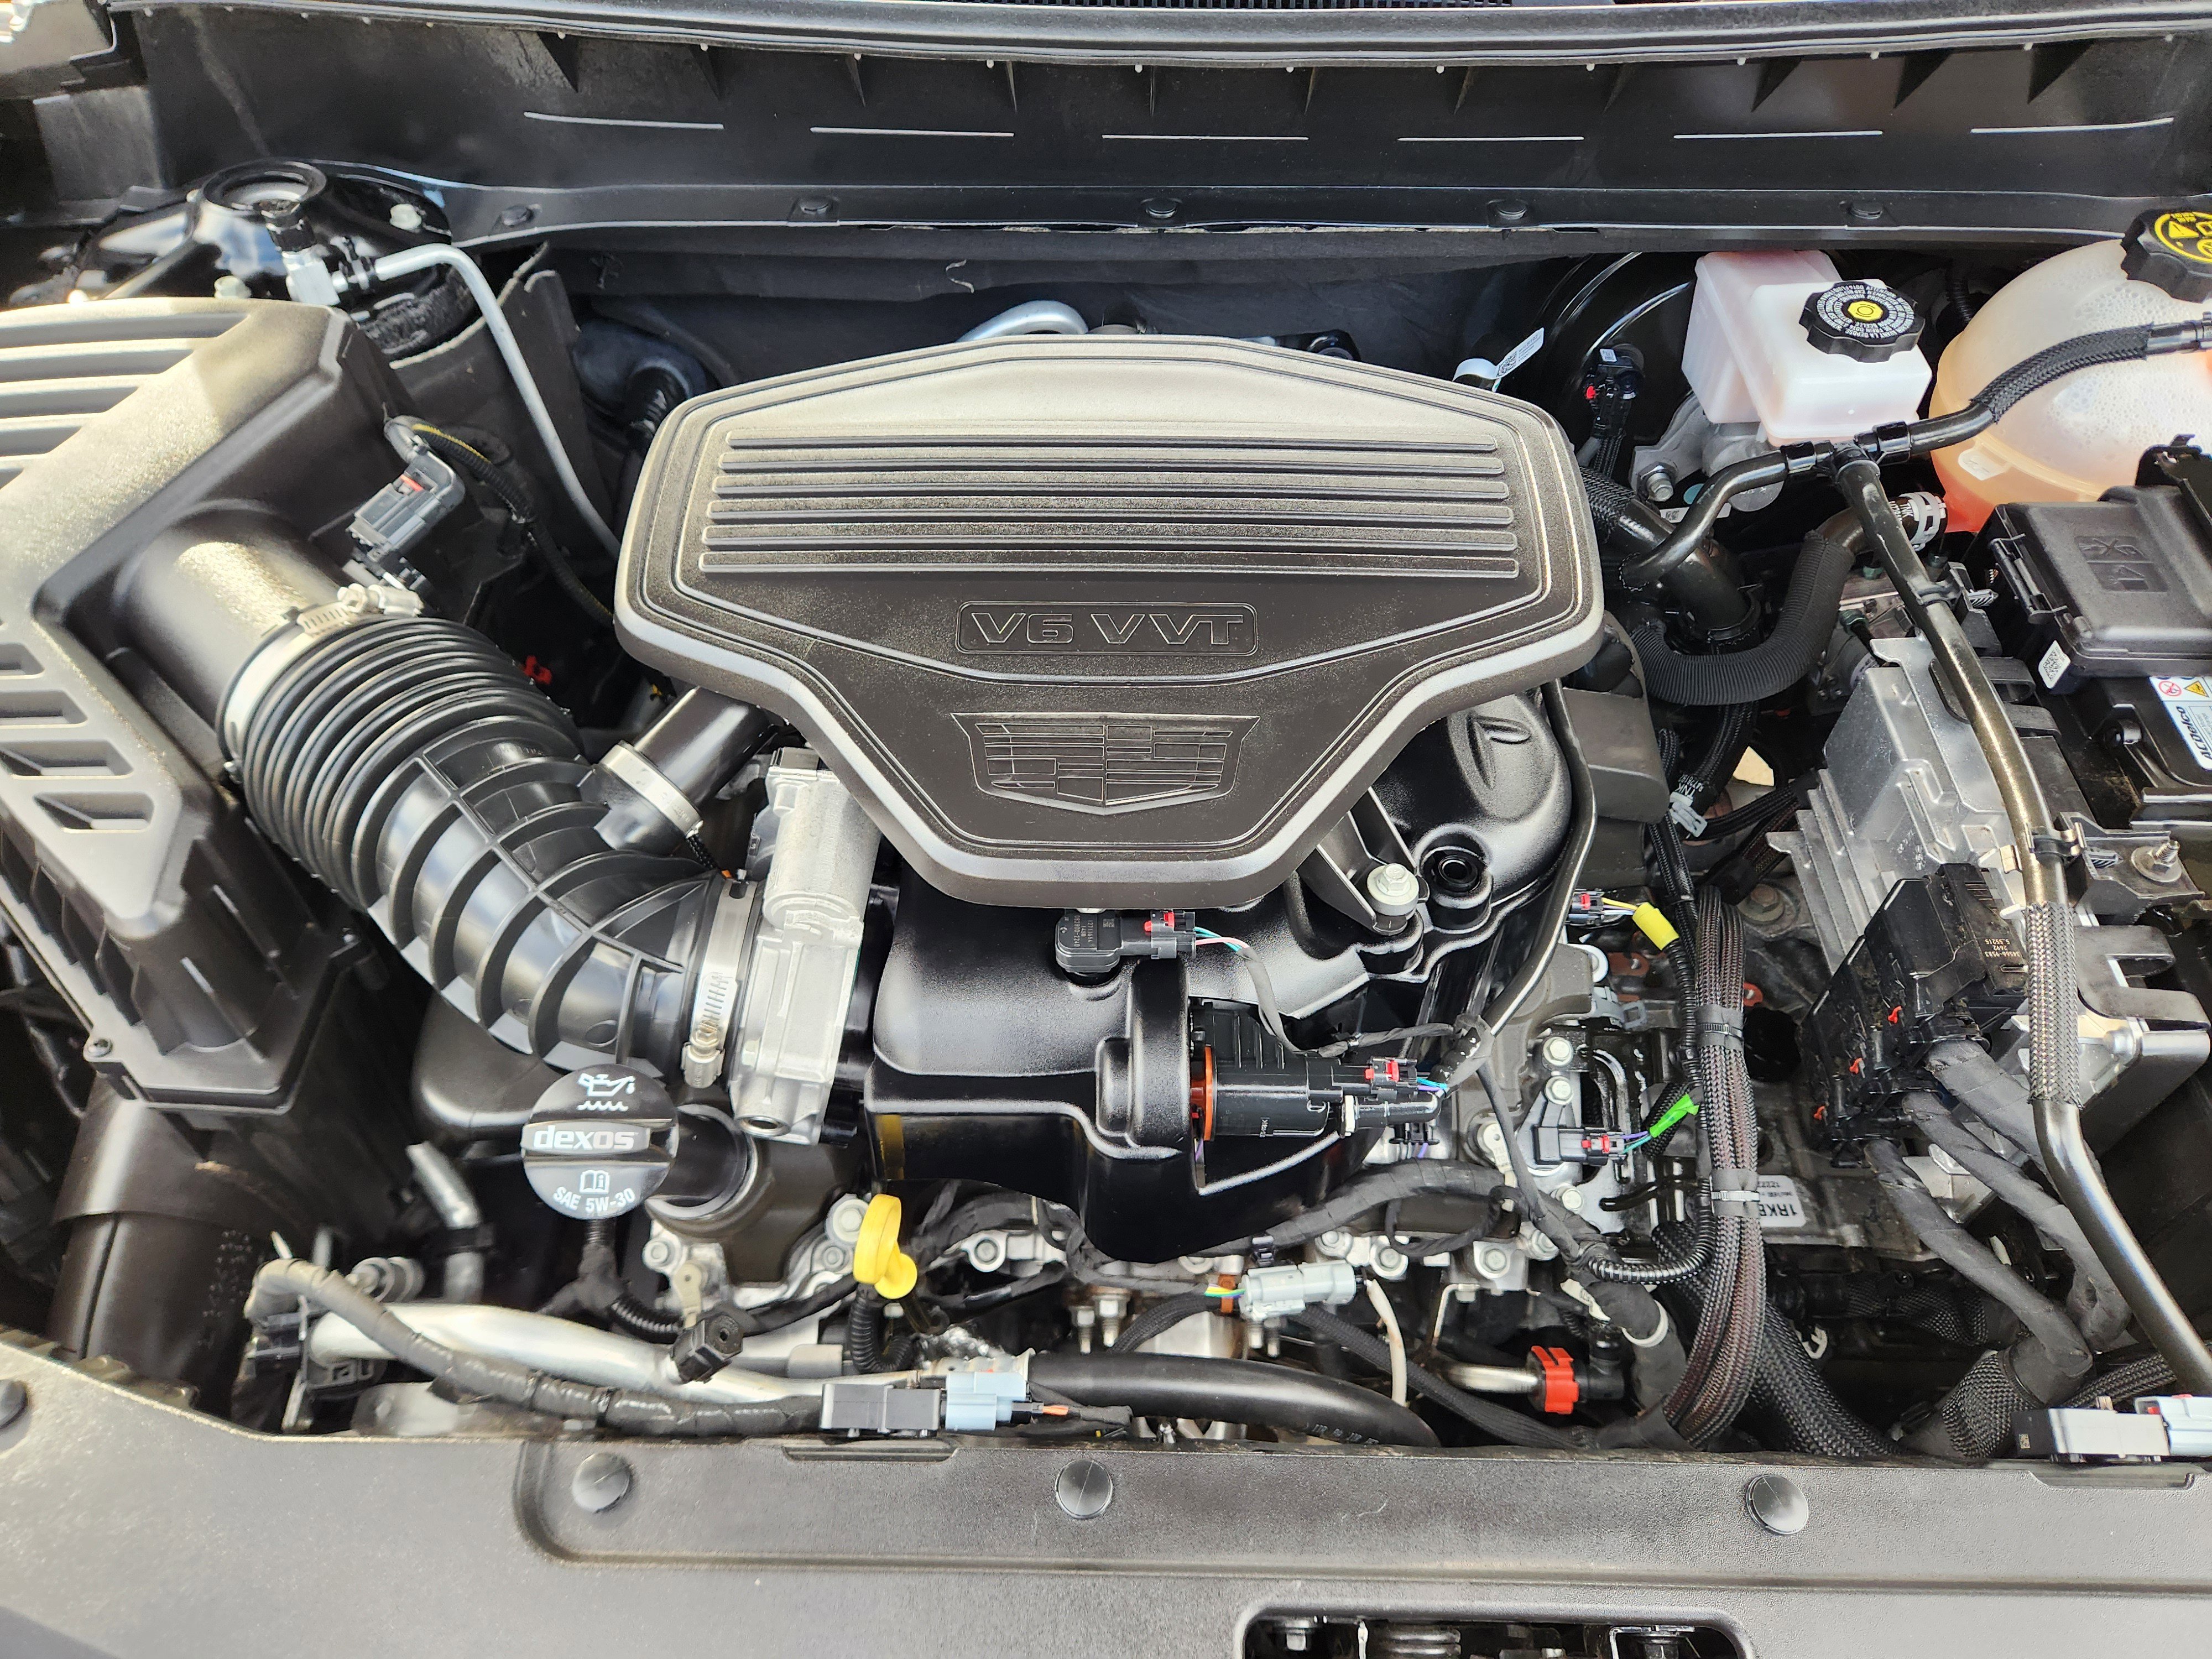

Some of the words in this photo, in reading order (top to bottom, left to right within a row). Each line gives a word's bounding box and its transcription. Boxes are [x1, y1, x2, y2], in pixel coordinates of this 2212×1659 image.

[1900, 502, 1913, 518] TNK
[971, 613, 1073, 644] V6
[1091, 614, 1243, 645] VVT
[2176, 706, 2212, 760] ACDelco
[1674, 783, 1695, 797] TNK
[534, 1125, 638, 1150] dexos
[553, 1187, 581, 1210] SAE
[585, 1188, 636, 1213] 5W-30
